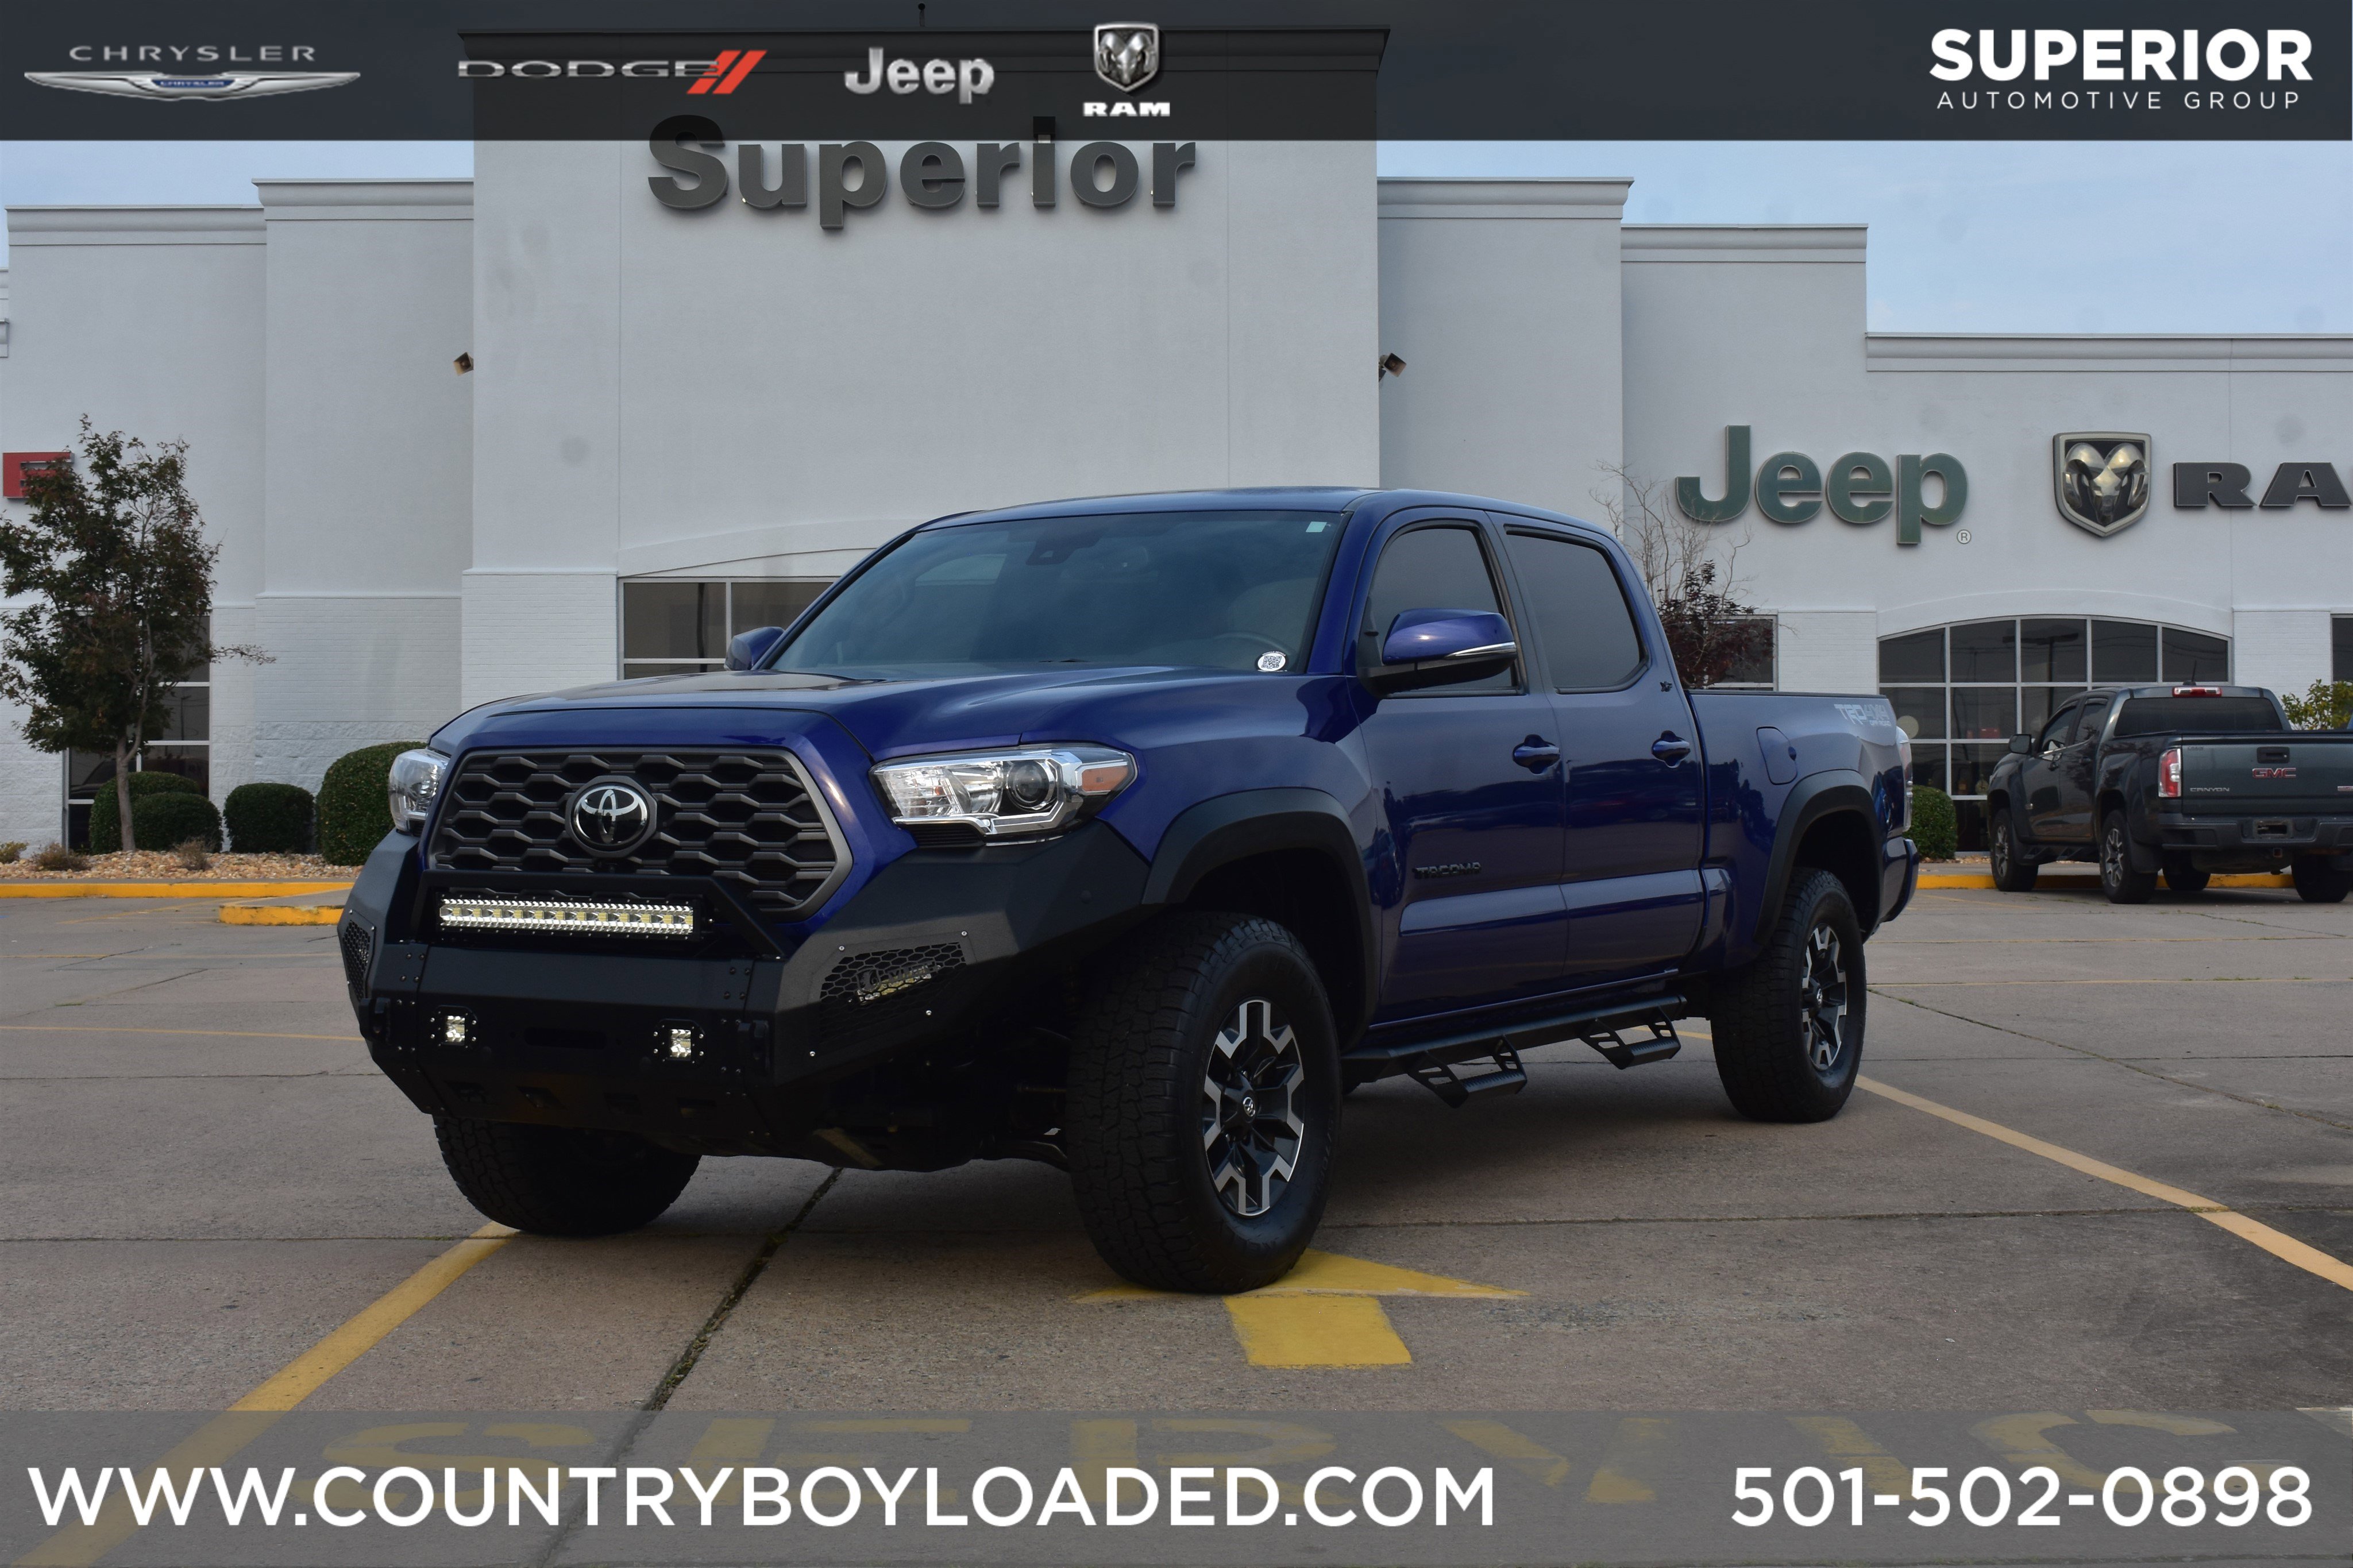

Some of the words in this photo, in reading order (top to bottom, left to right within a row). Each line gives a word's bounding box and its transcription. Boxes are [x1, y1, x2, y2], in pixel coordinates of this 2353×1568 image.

[648, 115, 1196, 229] Superior
[1675, 424, 1969, 544] Jeep
[1834, 704, 1867, 725] TRD
[2252, 767, 2296, 778] GMC
[1415, 862, 1481, 875] TACOMA
[284, 1407, 2353, 1509] SERVIC
